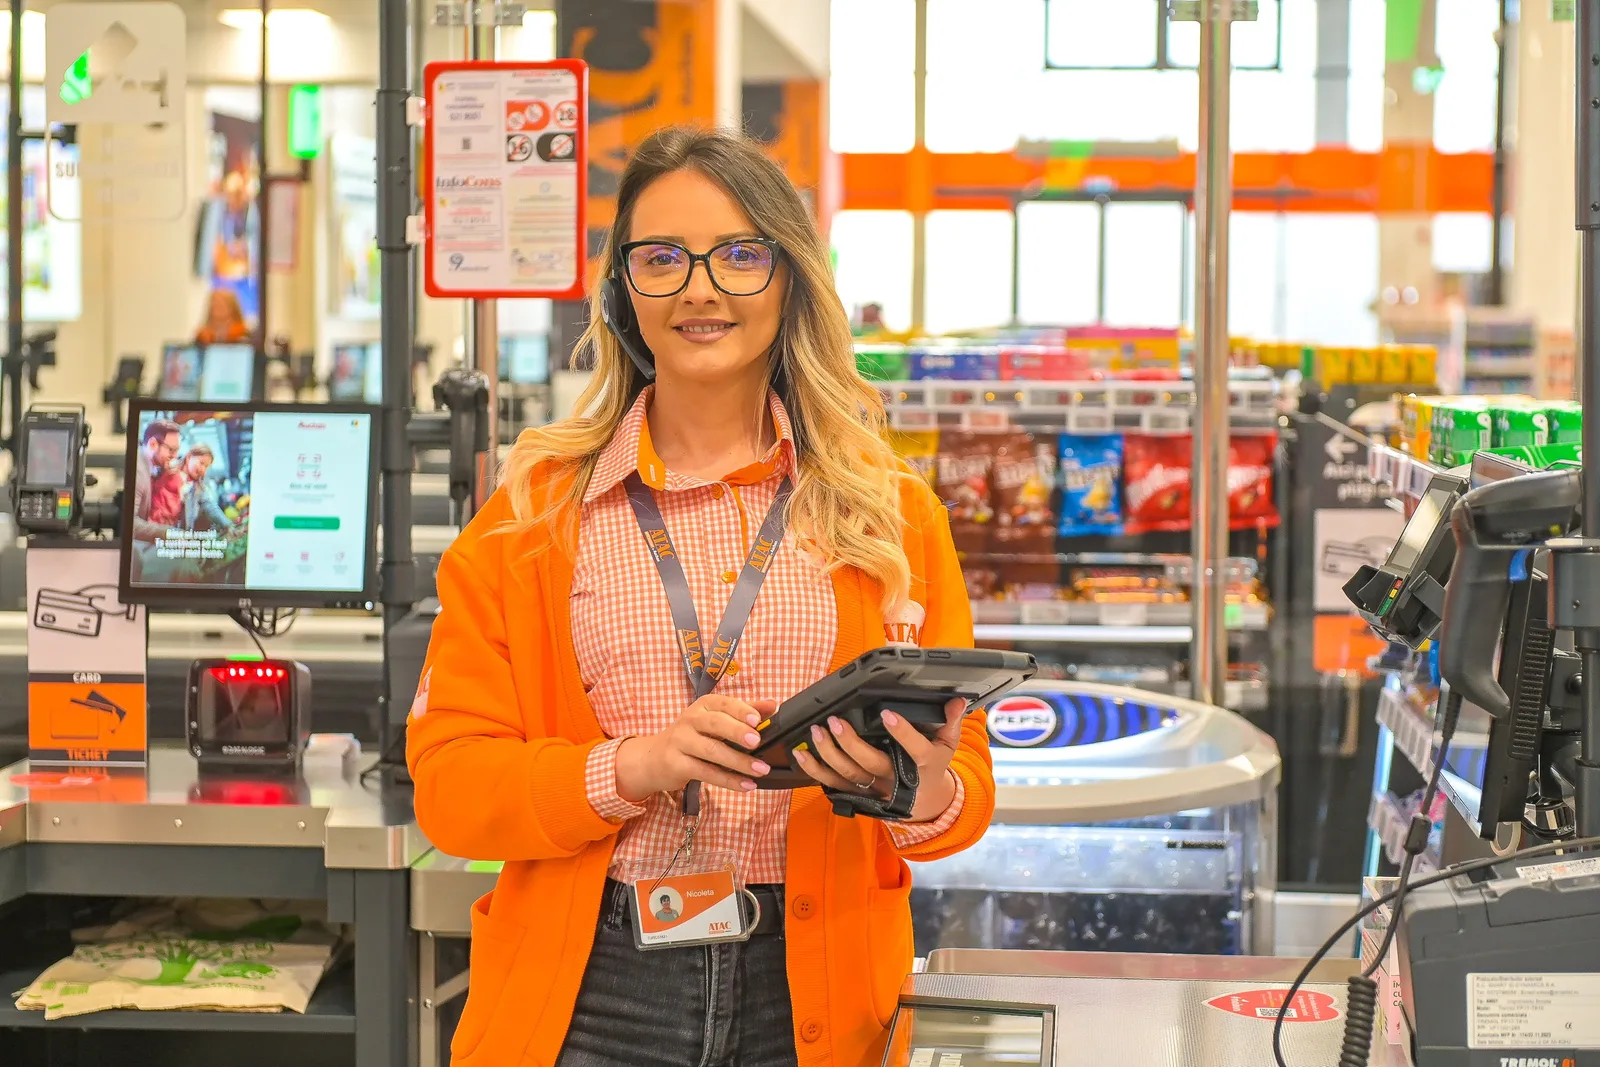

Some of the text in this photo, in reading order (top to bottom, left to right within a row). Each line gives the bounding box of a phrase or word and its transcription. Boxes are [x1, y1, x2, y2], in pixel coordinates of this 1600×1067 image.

[649, 529, 675, 561] ATAC
[749, 535, 774, 572] ATAC
[682, 629, 704, 674] ATAC
[706, 633, 732, 679] ATAC
[73, 672, 102, 684] CARD
[994, 714, 1051, 725] PEPSI
[67, 748, 110, 761] TICKET
[686, 889, 715, 898] Nicoleta
[709, 920, 732, 930] ATAC
